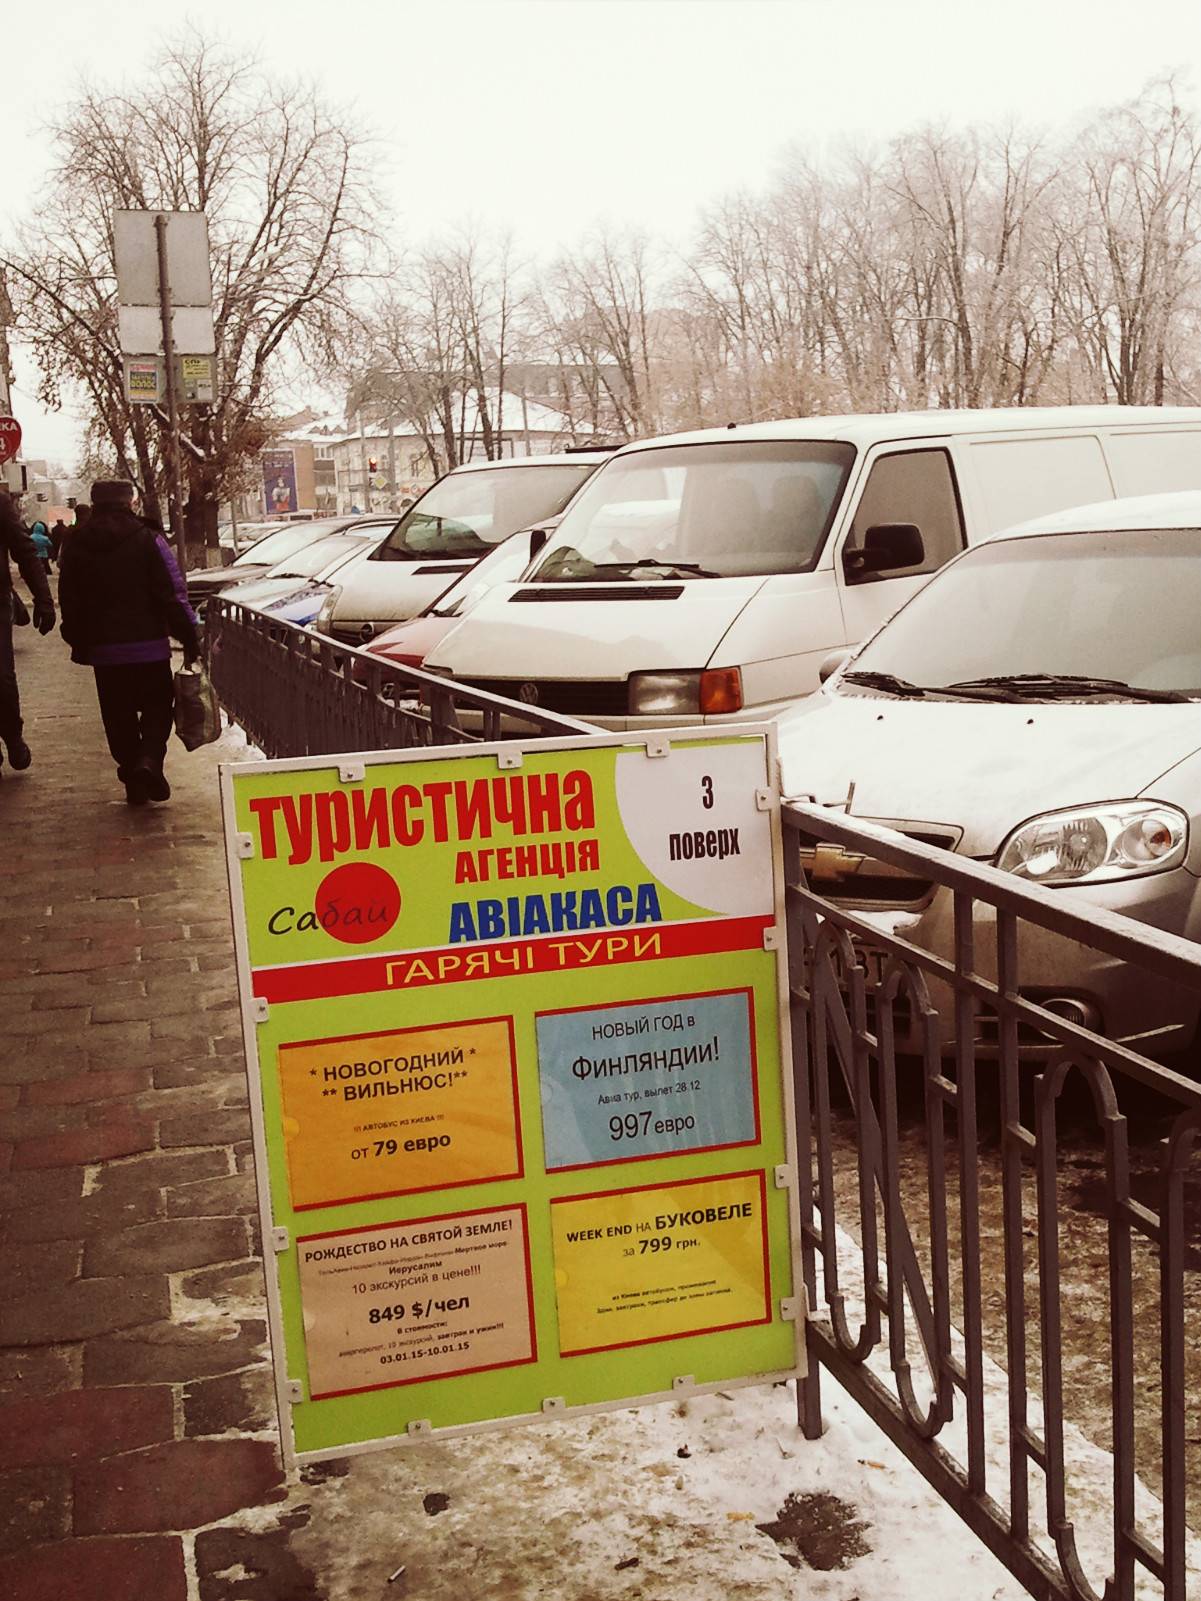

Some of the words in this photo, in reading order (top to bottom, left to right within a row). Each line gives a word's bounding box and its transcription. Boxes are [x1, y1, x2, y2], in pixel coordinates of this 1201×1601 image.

[0, 422, 18, 431] КА
[701, 776, 714, 809] 3
[455, 839, 600, 884] АГЕНЦІЯ
[449, 883, 662, 943] АВІАКАСА
[386, 947, 534, 985] ГАРЯЧІ
[549, 933, 661, 966] ТУРИ
[592, 1016, 649, 1040] НОВЫЙ
[654, 1014, 684, 1032] ГОД
[324, 1047, 464, 1081] НОВОГОДНИЙ
[609, 1111, 652, 1140] 997
[654, 1115, 695, 1135] евро
[351, 1147, 369, 1160] от
[373, 1139, 397, 1157] 79
[404, 1135, 451, 1153] евро
[567, 1228, 603, 1243] WEEK
[606, 1225, 632, 1238] END
[655, 1202, 752, 1230] БУКОВЕЛЕ
[305, 1240, 387, 1262] РОЖДЕСТВО
[390, 1236, 409, 1249] НА
[411, 1226, 462, 1245] СВЯТОЙ
[465, 1219, 513, 1237] ЗЕМЛЕ!
[639, 1236, 672, 1255] 799
[389, 1260, 443, 1275] Иерусалим
[353, 1283, 367, 1295] 10
[370, 1273, 429, 1292] экскурсий
[369, 1304, 405, 1324] 849
[380, 1341, 470, 1364] 03.01.15-10.01.15
